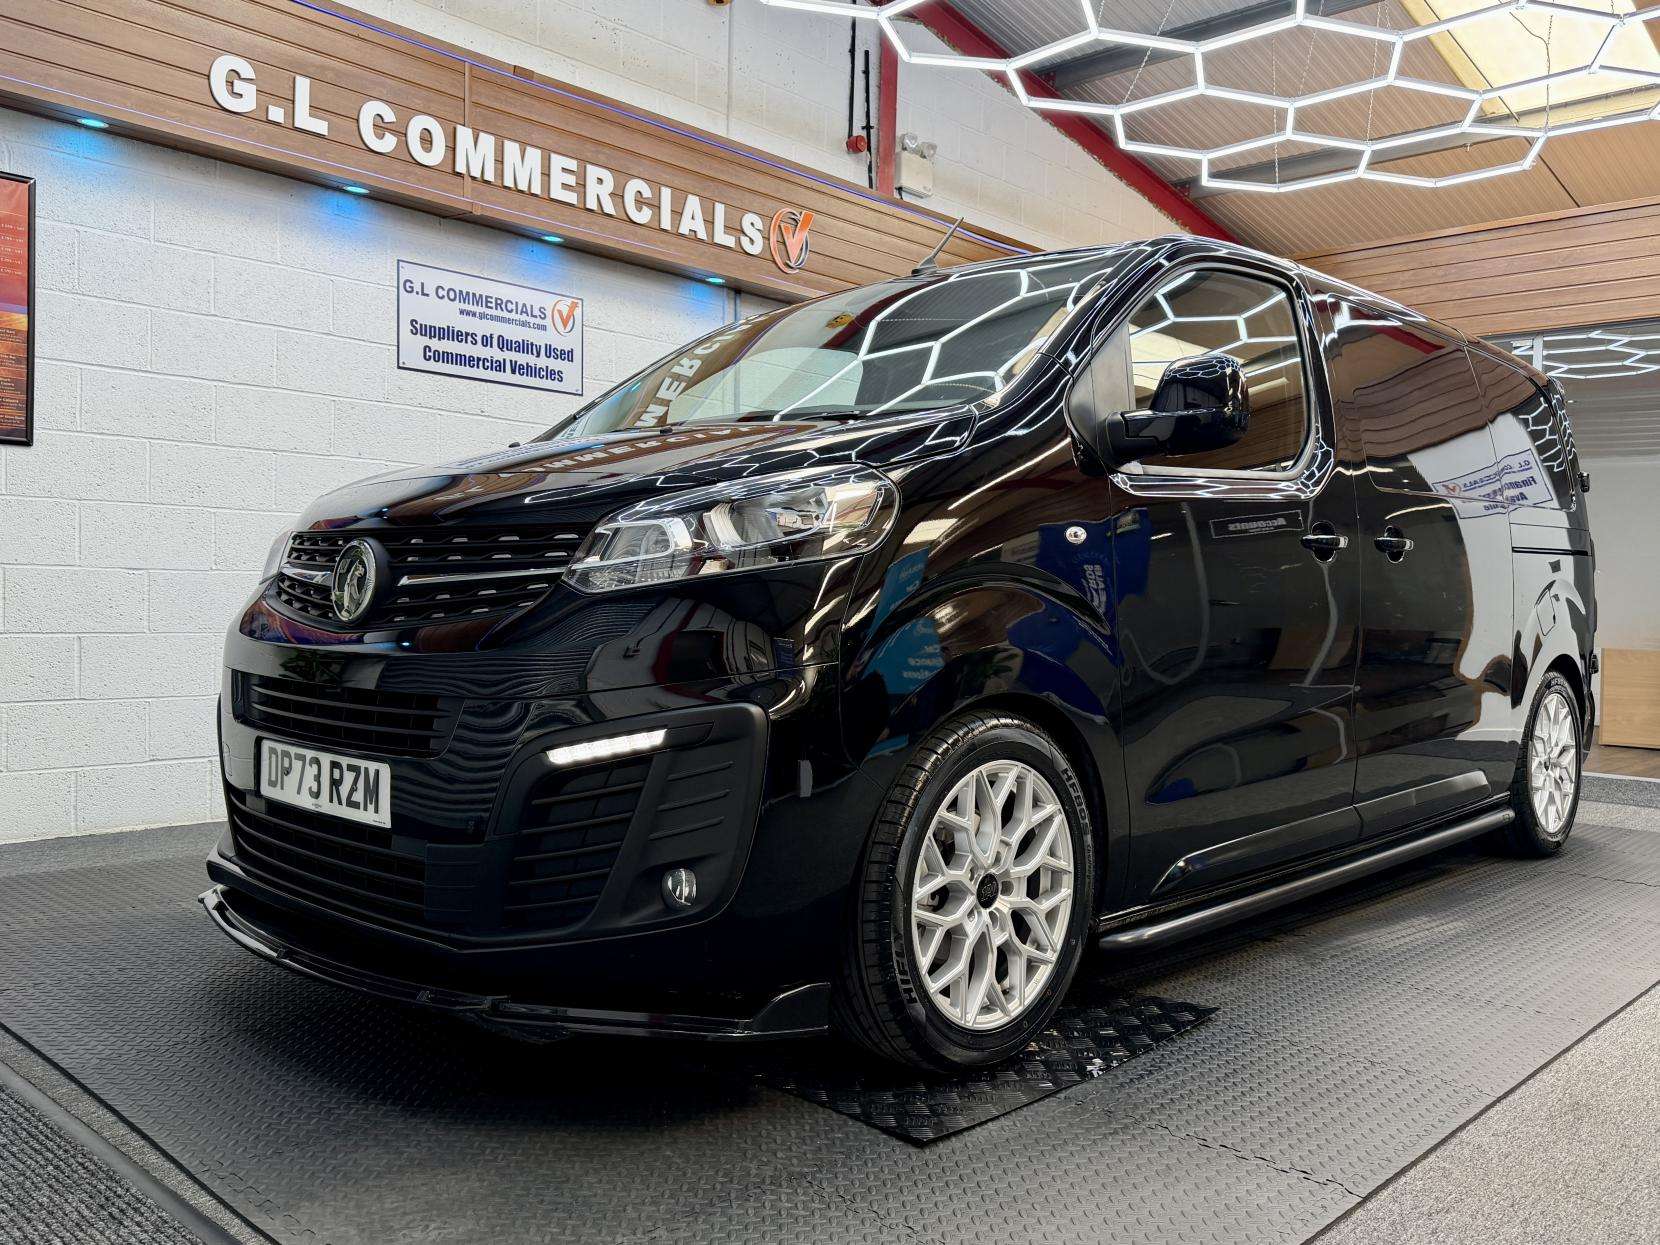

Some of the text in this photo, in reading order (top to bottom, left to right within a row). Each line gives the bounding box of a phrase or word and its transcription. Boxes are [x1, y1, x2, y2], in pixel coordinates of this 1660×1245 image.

[209, 54, 764, 255] G.L COMMERCIALS
[402, 278, 547, 320] G.L COMMERCIALS
[458, 306, 547, 332] www.glcommercials.com
[409, 319, 574, 363] Suppliers of Quality Used
[422, 345, 564, 382] Commercial Vehicles
[267, 746, 380, 815] DP73 RZM
